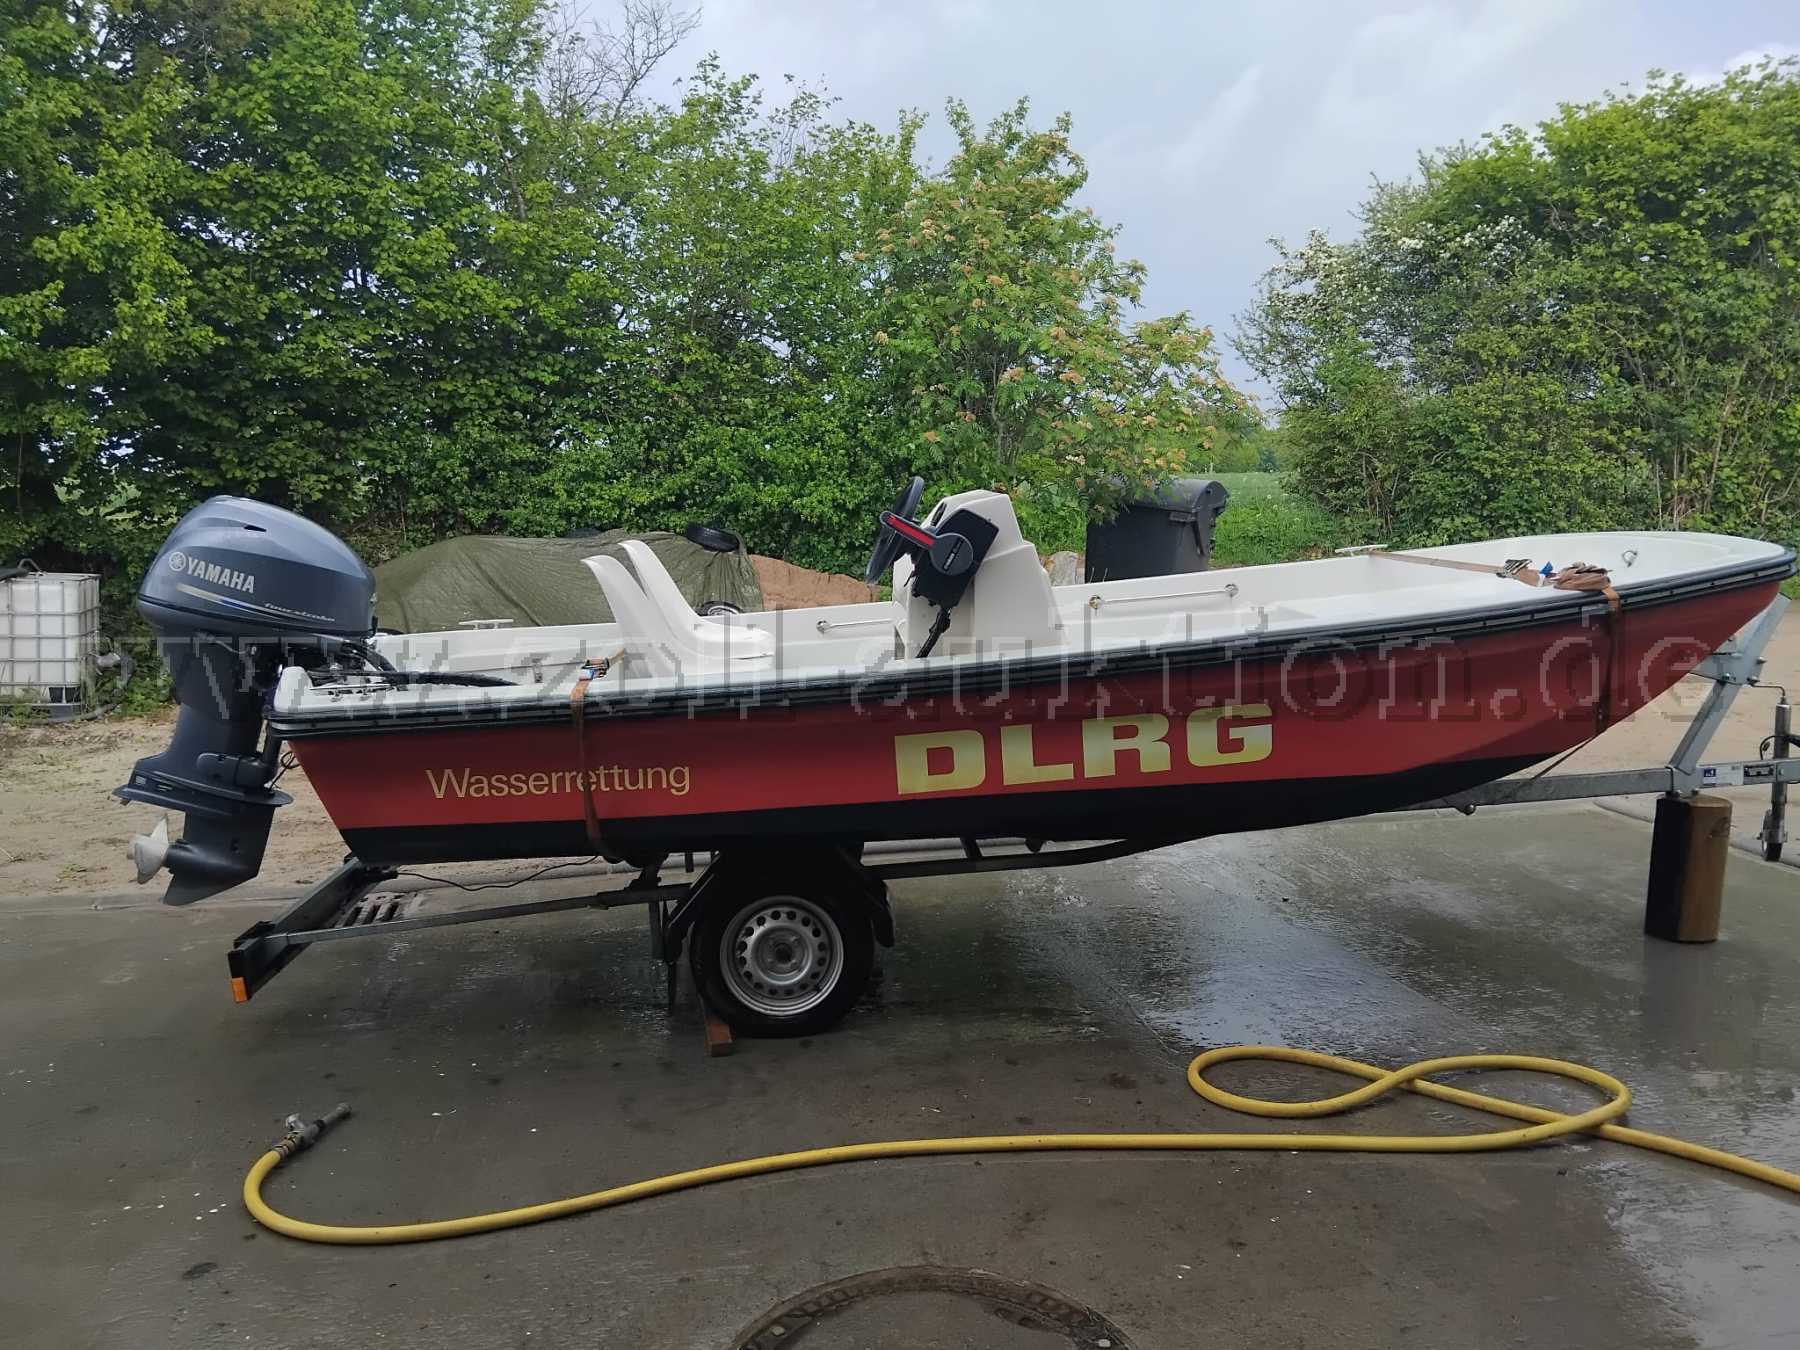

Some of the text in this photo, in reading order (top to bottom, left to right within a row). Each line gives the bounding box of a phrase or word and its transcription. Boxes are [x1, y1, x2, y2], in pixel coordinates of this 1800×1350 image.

[187, 556, 255, 594] YAMAHA
[894, 703, 1272, 795] DLRG
[425, 764, 691, 797] Wasserrettung
